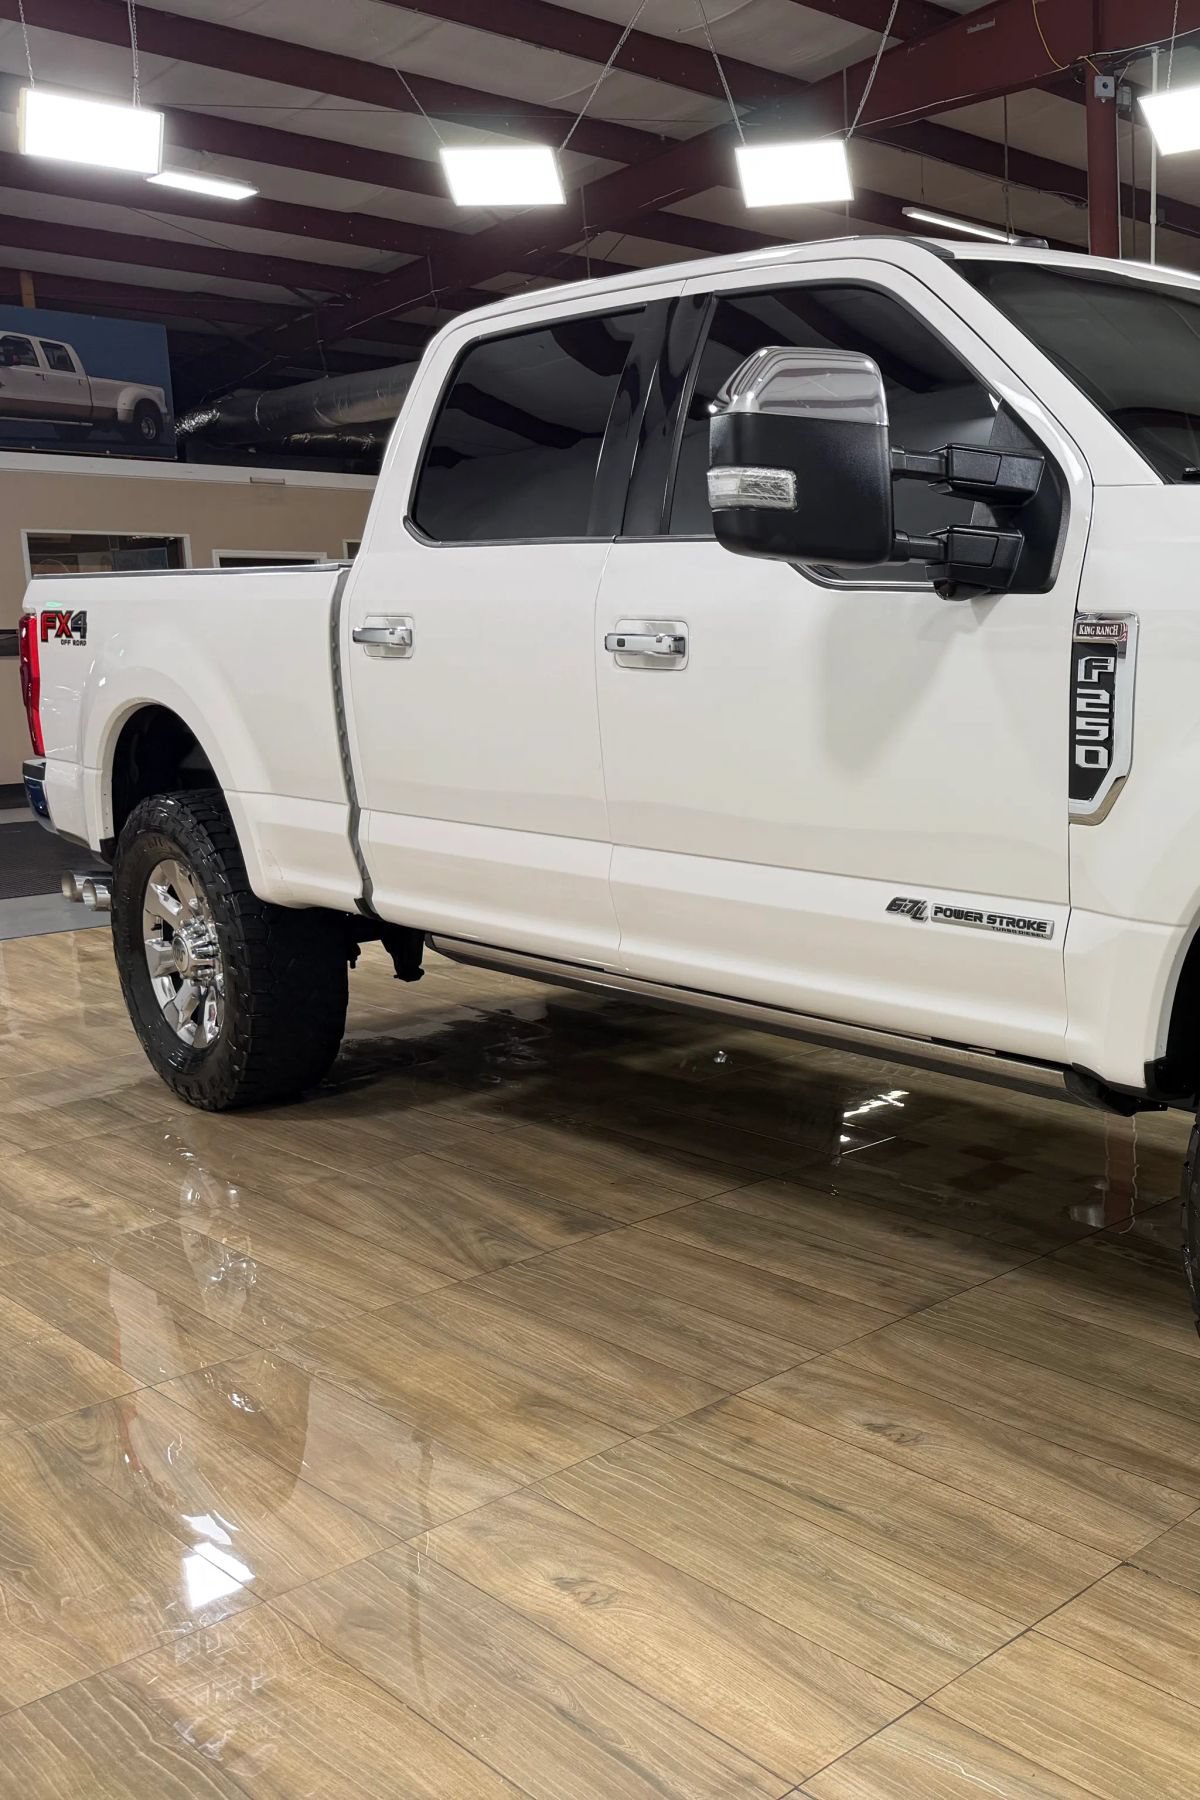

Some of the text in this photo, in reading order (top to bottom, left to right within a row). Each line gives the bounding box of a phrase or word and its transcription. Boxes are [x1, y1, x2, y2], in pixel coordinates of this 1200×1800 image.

[41, 610, 88, 643] FX4
[1079, 625, 1119, 636] KING RANCH
[933, 905, 984, 923] POWER
[986, 913, 1048, 933] STROKE
